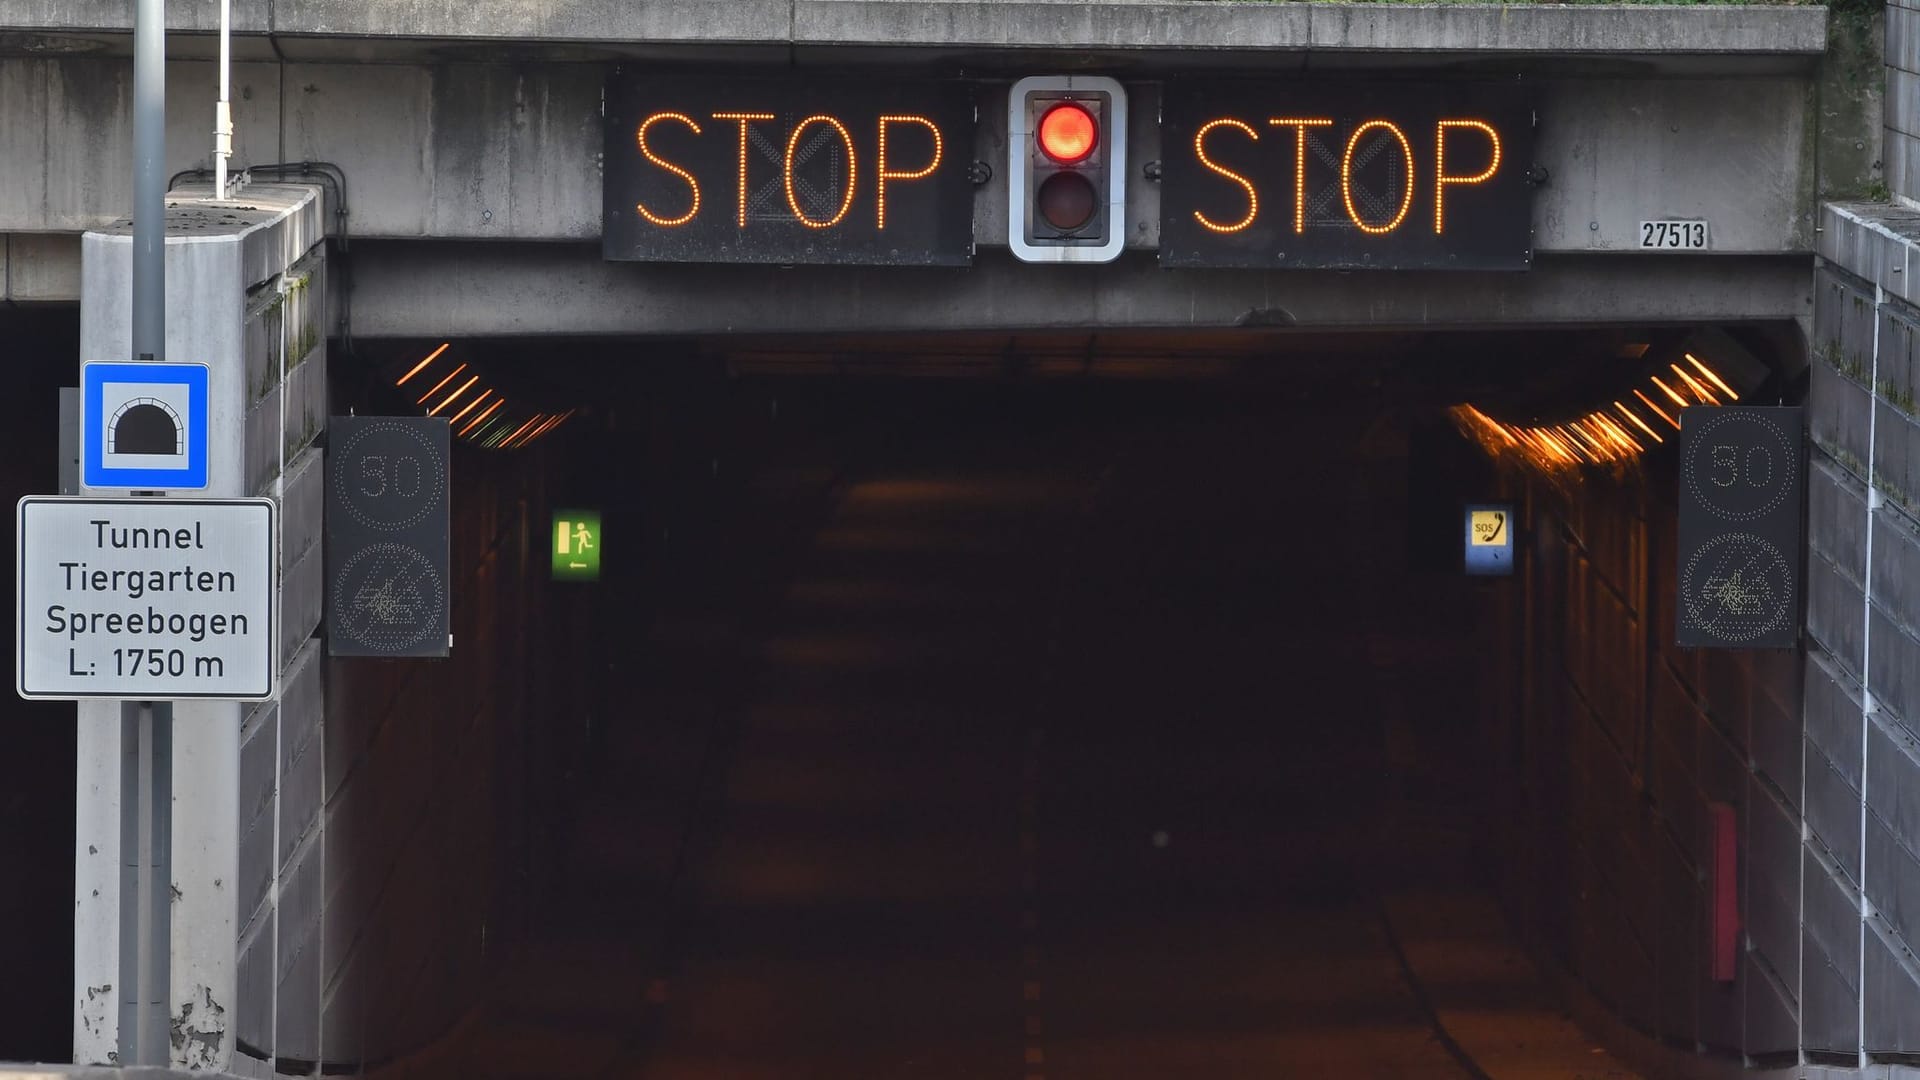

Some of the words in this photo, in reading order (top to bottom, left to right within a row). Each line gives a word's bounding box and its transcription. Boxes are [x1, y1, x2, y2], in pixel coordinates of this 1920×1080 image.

[636, 112, 943, 229] STOP
[1193, 117, 1502, 235] STOP
[1642, 222, 1705, 248] 27513
[90, 520, 204, 550] Tunnel
[1475, 523, 1494, 533] SOS
[58, 562, 235, 599] Tiergarten
[46, 604, 248, 643] Spreebogen
[69, 648, 96, 677] L:
[113, 648, 185, 677] 1750
[195, 656, 224, 677] m
